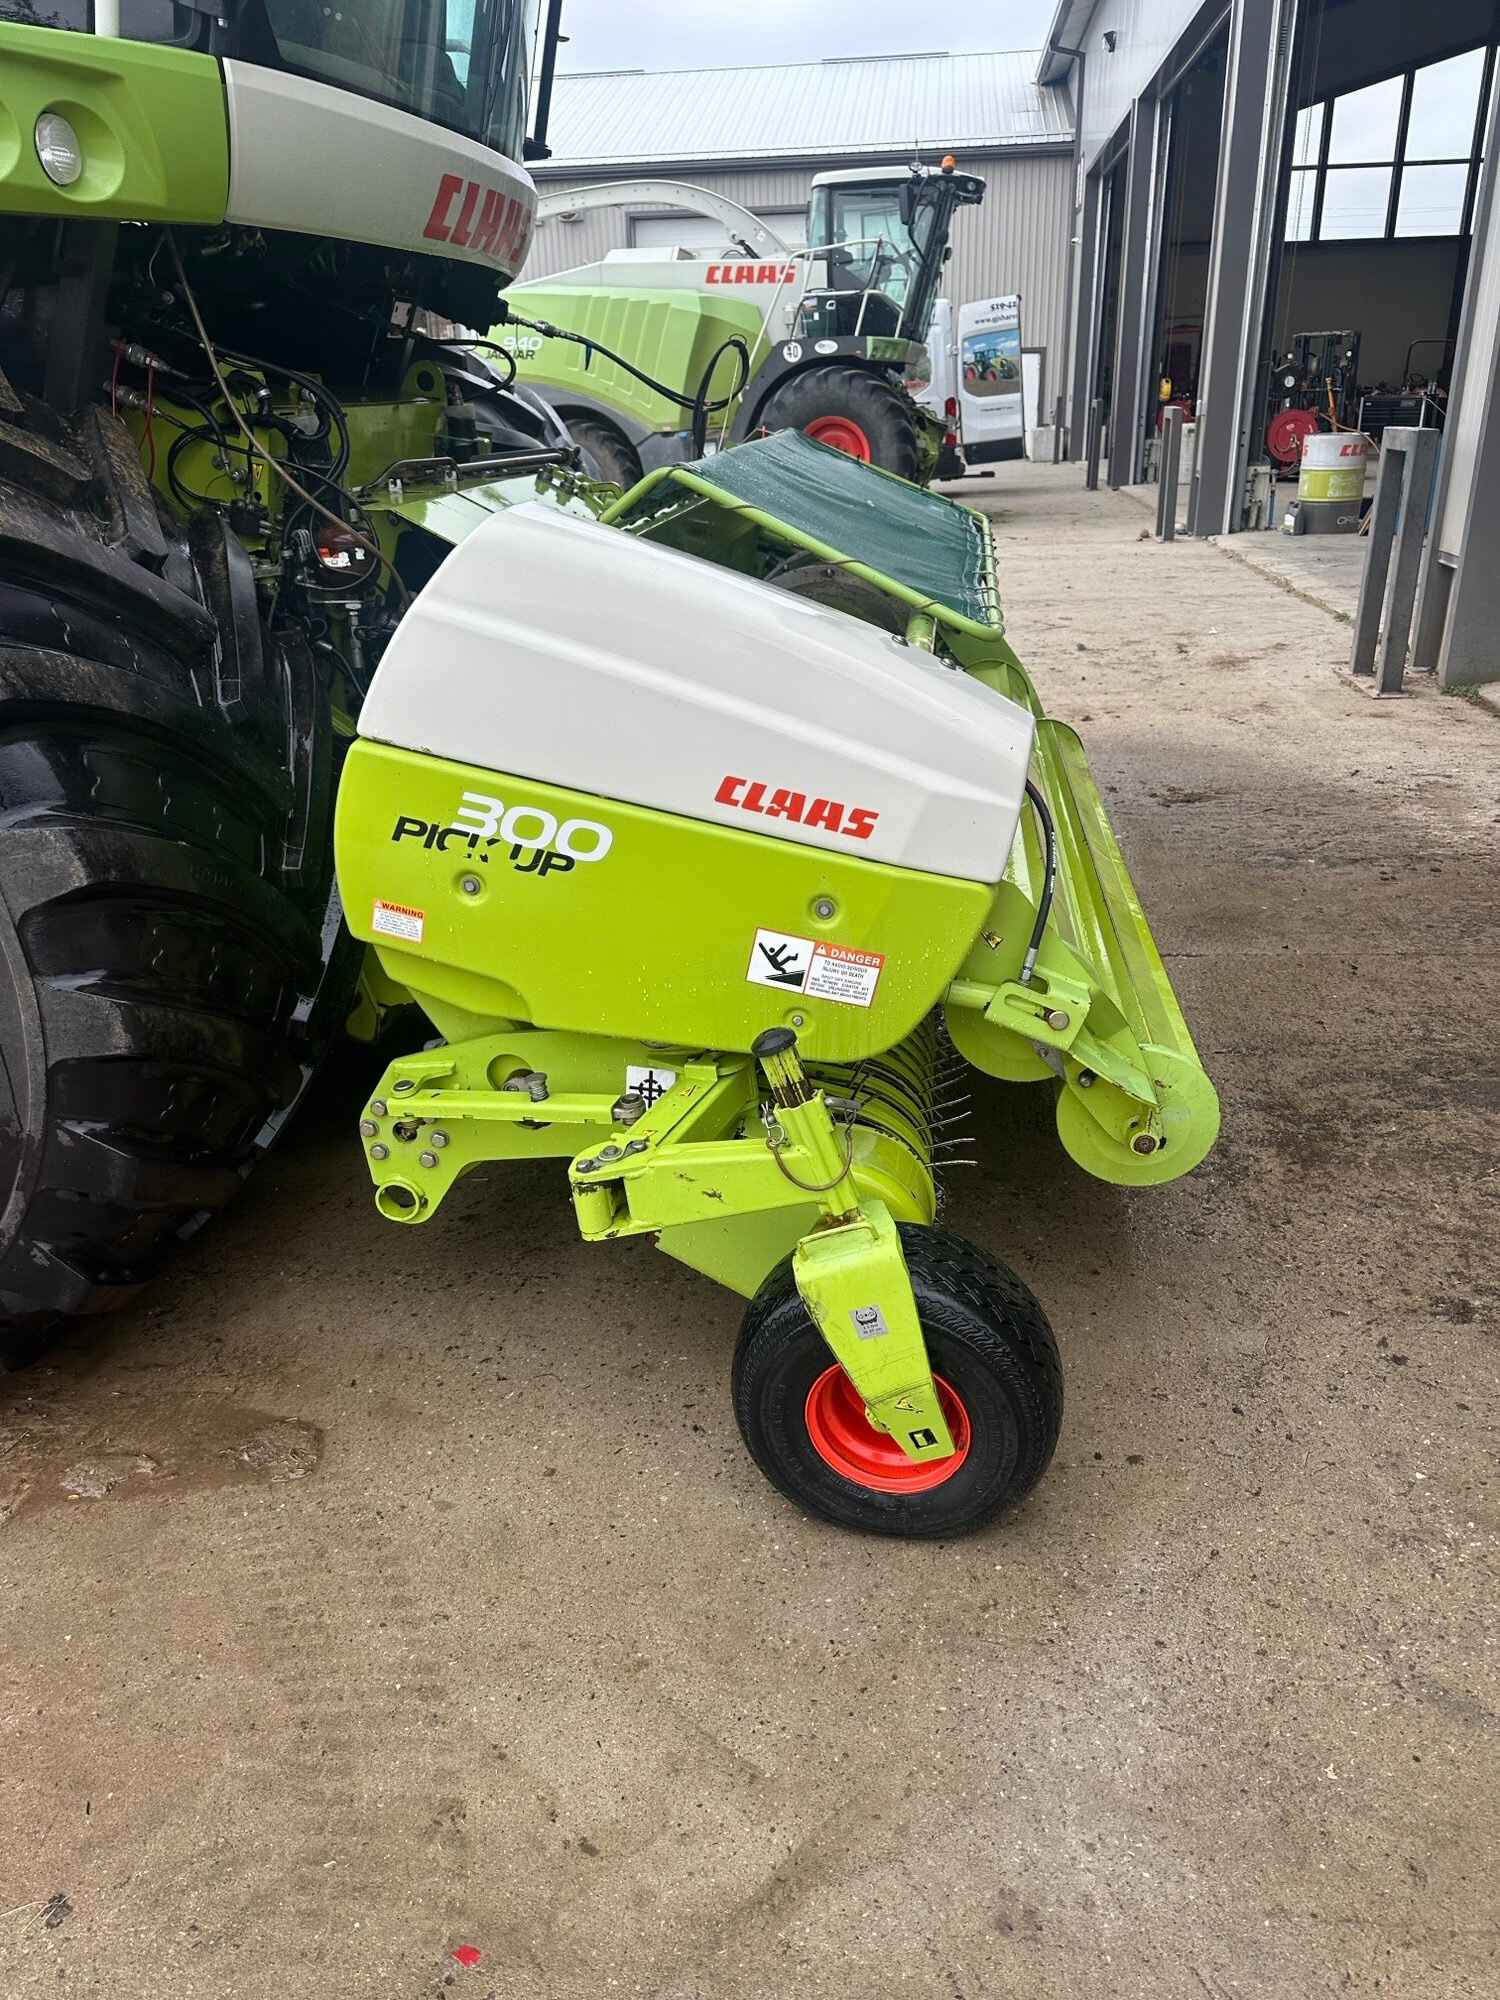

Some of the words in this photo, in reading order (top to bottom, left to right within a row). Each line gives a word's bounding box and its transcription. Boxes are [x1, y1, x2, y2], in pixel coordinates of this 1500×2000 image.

[423, 173, 532, 263] CLAAS
[705, 264, 796, 284] CLAAS
[503, 335, 543, 352] 940
[786, 345, 799, 358] 40
[714, 775, 880, 840] CLAAS
[450, 791, 614, 862] 300
[382, 902, 424, 919] WARNING
[830, 948, 881, 967] DANGER
[848, 971, 865, 979] DEATH
